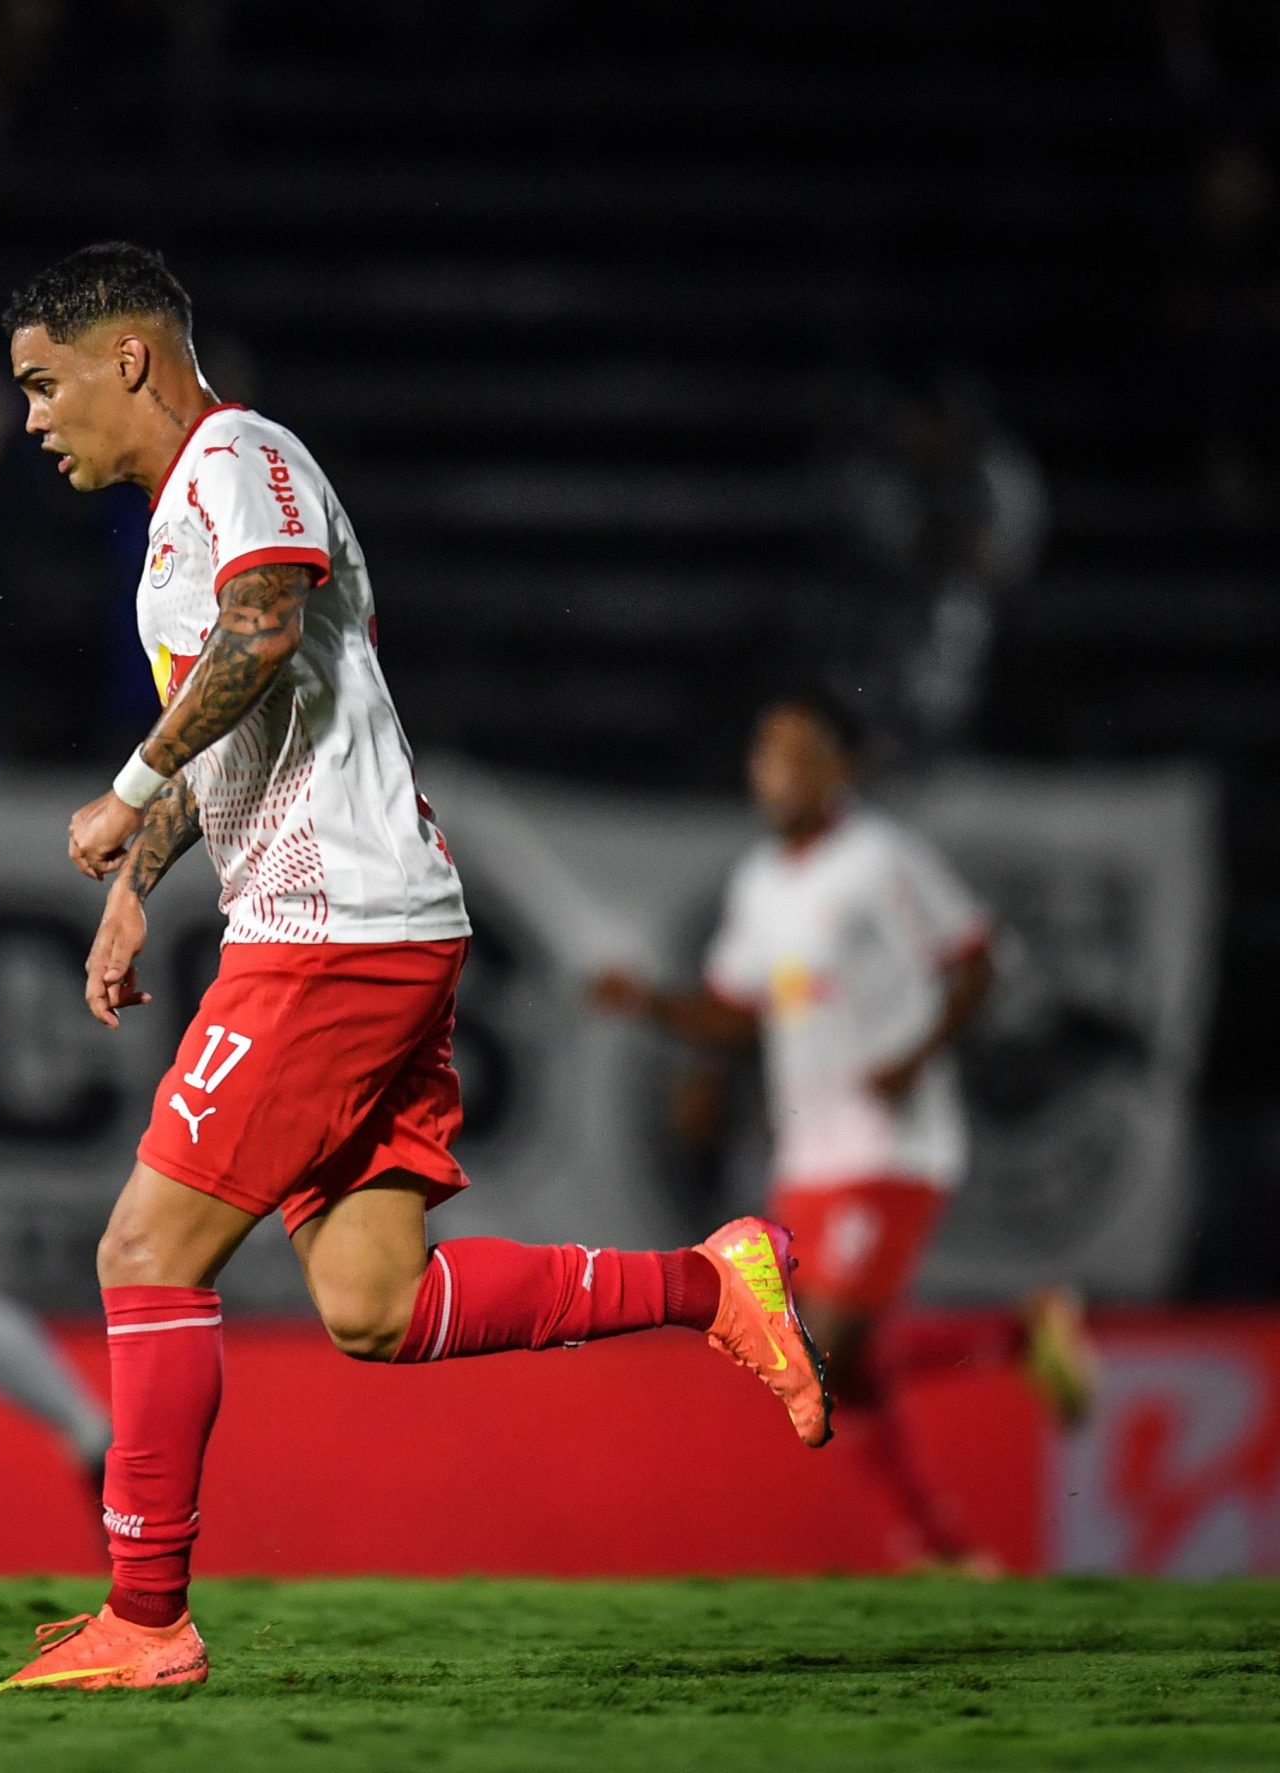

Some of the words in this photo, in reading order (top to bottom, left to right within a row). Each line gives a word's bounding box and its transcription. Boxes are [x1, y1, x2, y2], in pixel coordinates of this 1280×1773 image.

[259, 445, 305, 537] betfast
[183, 1024, 253, 1094] 17
[721, 1231, 788, 1312] NIKE
